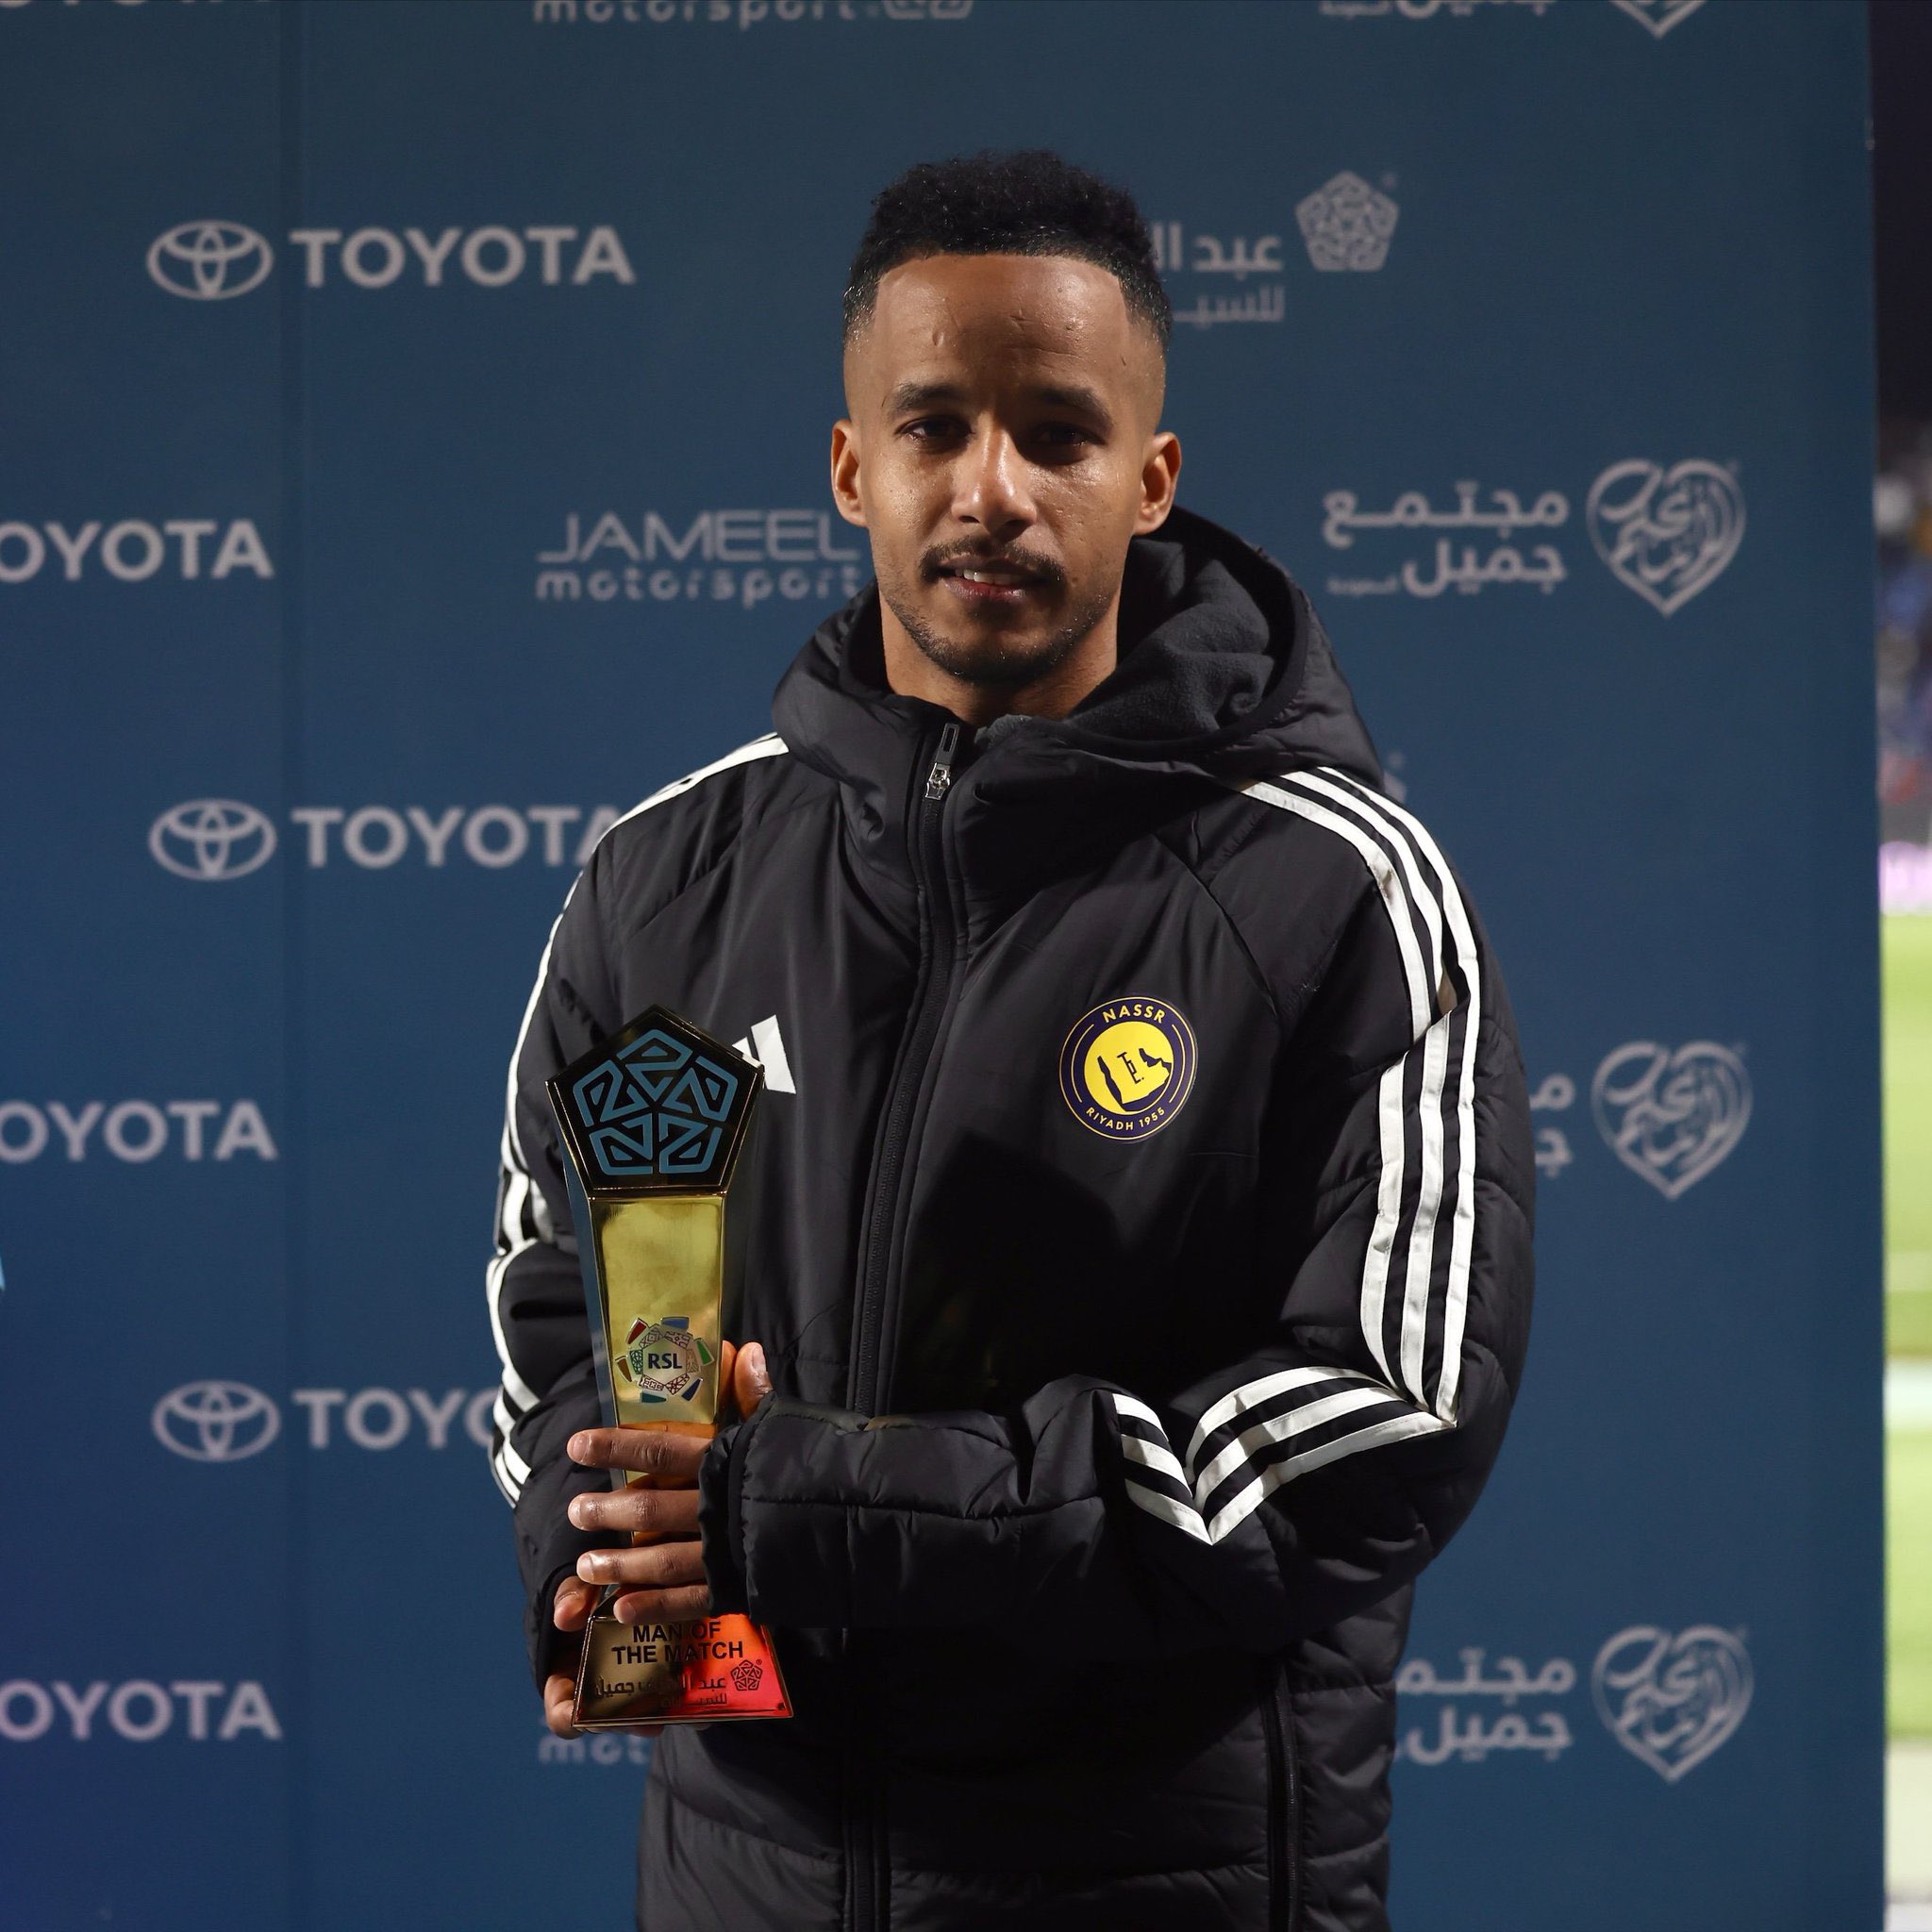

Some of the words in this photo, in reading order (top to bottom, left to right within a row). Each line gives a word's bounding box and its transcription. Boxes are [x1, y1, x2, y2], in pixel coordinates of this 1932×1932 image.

[290, 226, 635, 288] TOYOTA
[1194, 235, 1283, 280] عبد
[540, 510, 860, 561] JAMEEL
[1323, 481, 1570, 549] مجتمع
[0, 520, 274, 582] OYOTA
[1401, 538, 1567, 597] جميل
[535, 566, 858, 608] motorsport
[1102, 1004, 1166, 1024] NASSR
[0, 1100, 277, 1162] OYOTA
[1086, 1107, 1134, 1130] RIYADH
[1139, 1108, 1165, 1127] 1955
[648, 1353, 682, 1370] RSL
[611, 1644, 658, 1665] THE
[664, 1641, 743, 1662] MATCH
[633, 1624, 682, 1643] MAN
[691, 1621, 722, 1640] OF
[0, 1679, 281, 1741] OYOTA
[1407, 1706, 1573, 1765] جميل
